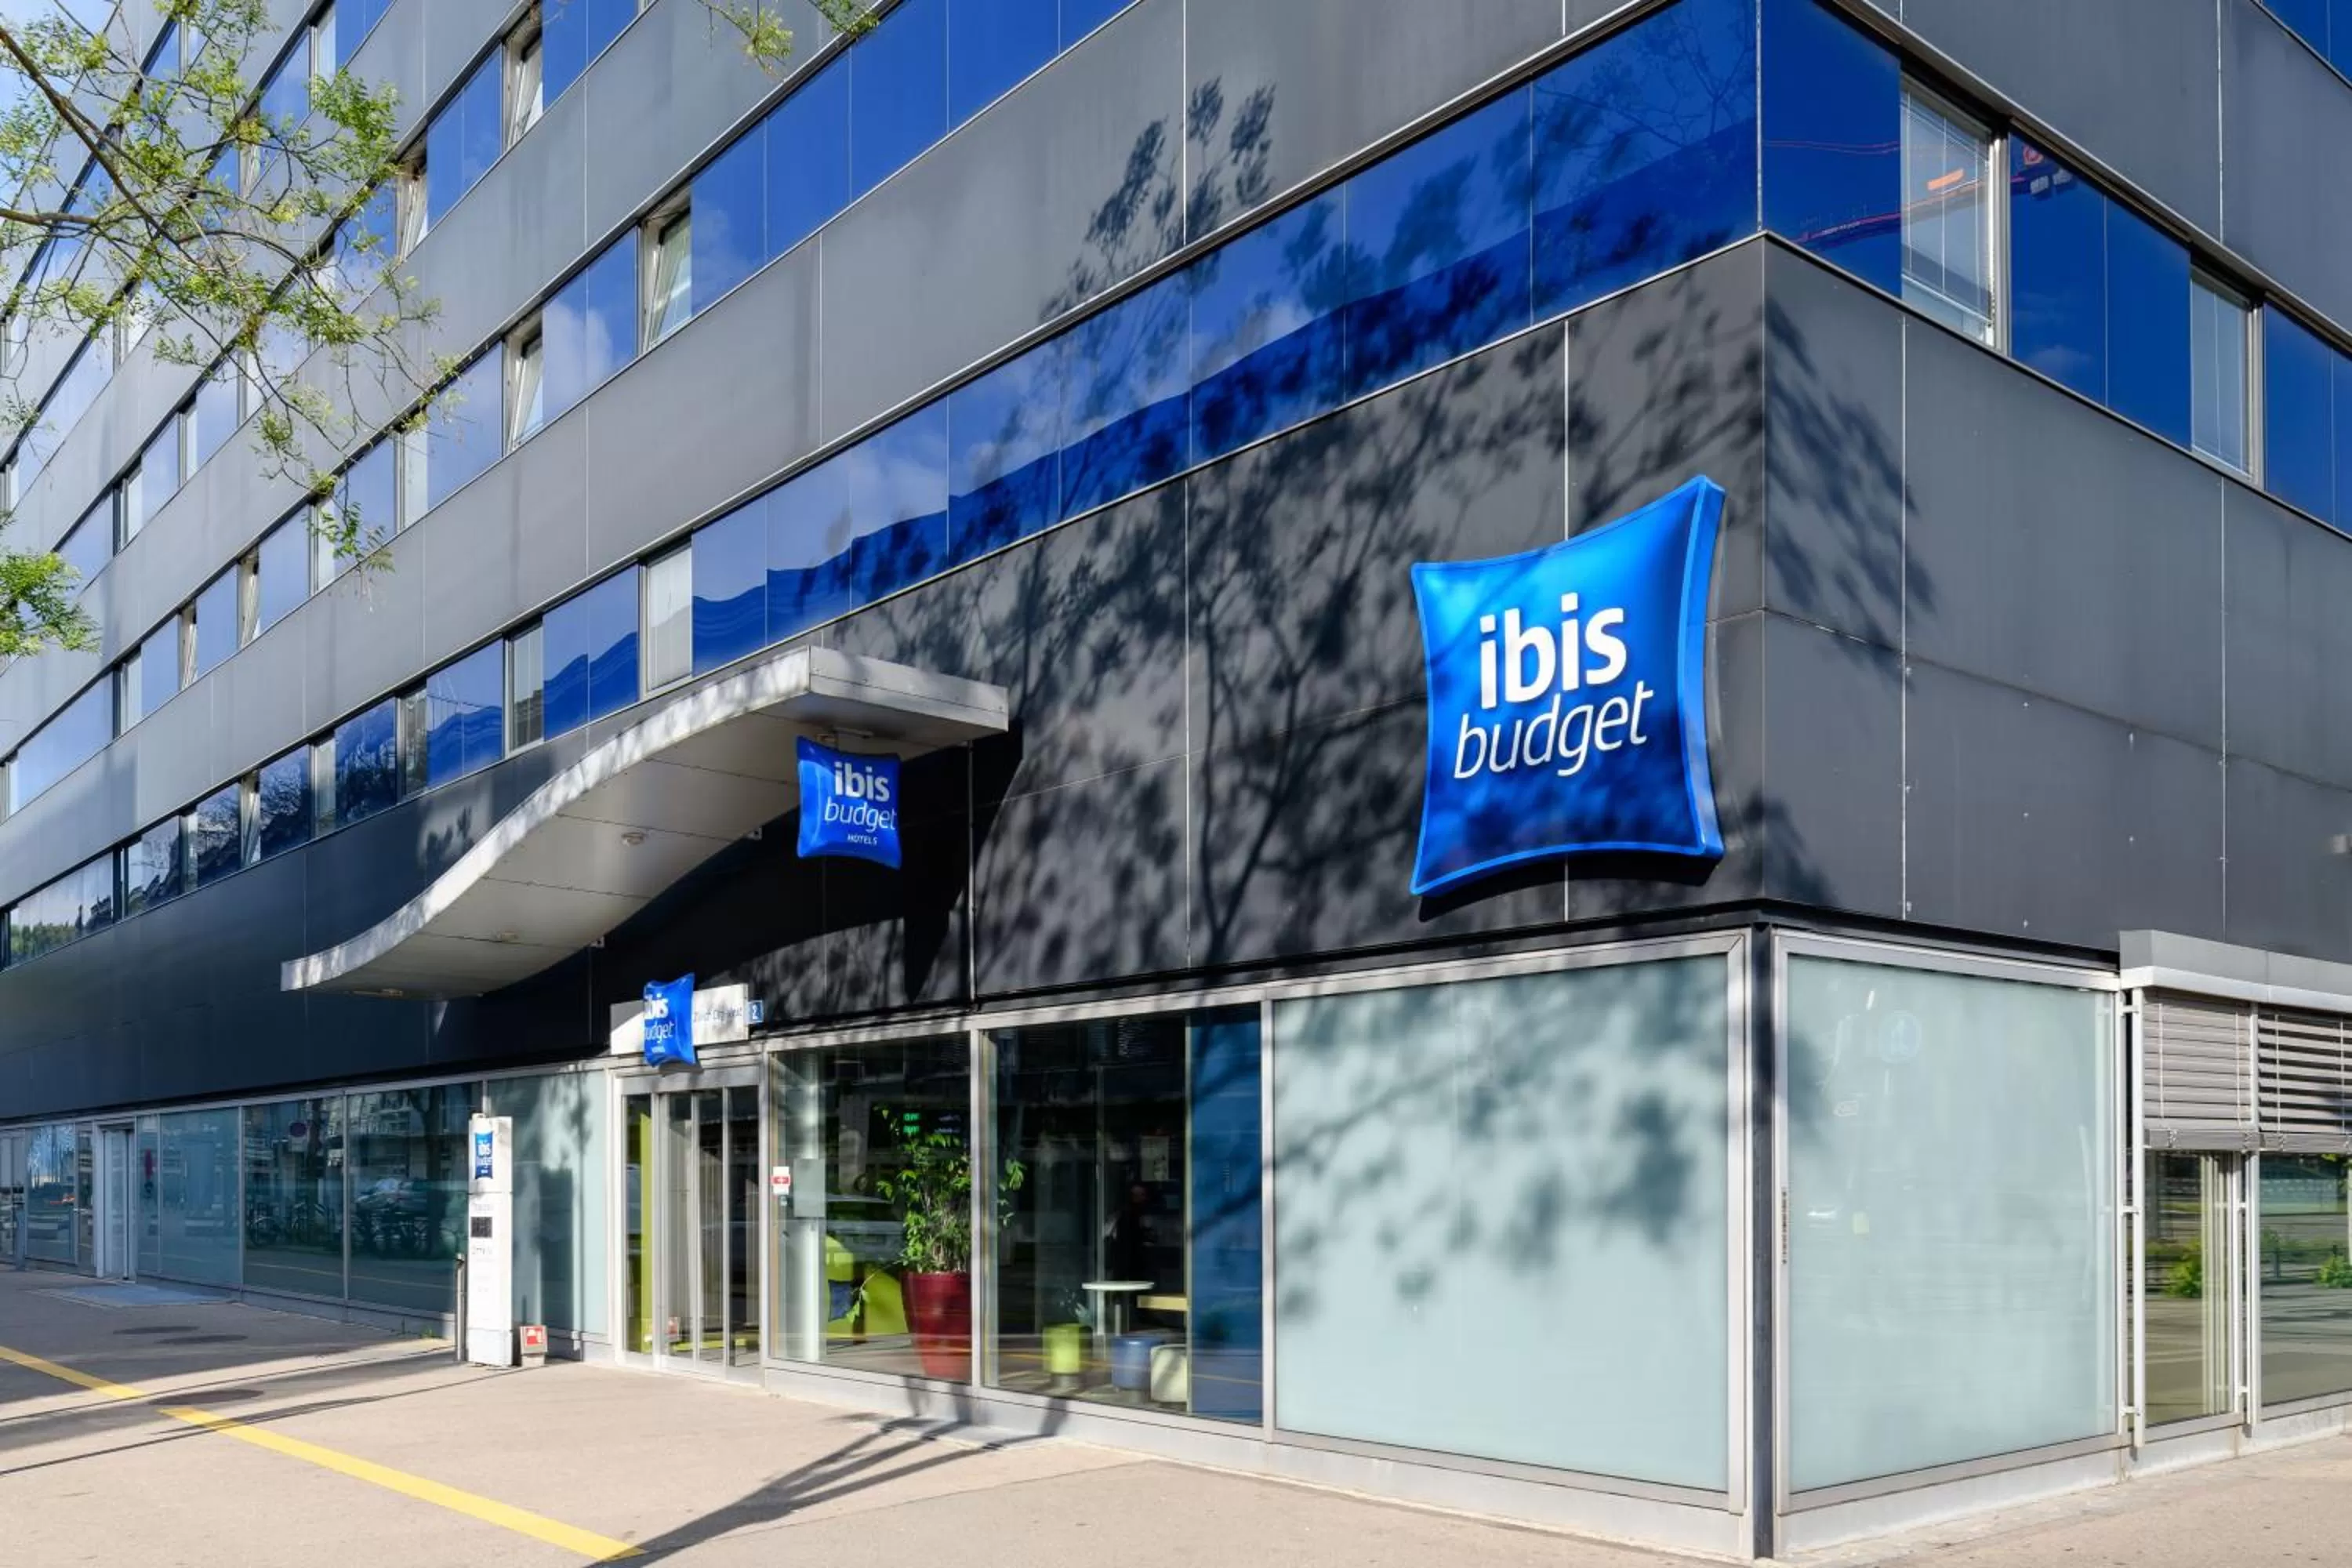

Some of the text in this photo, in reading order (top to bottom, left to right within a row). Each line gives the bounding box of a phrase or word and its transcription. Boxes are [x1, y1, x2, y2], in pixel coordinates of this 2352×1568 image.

[1479, 592, 1628, 709] ibis
[1454, 681, 1654, 779] budget
[834, 761, 890, 802] ibis
[825, 797, 897, 833] budget
[848, 833, 878, 847] HOTELS
[644, 1020, 675, 1044] udget
